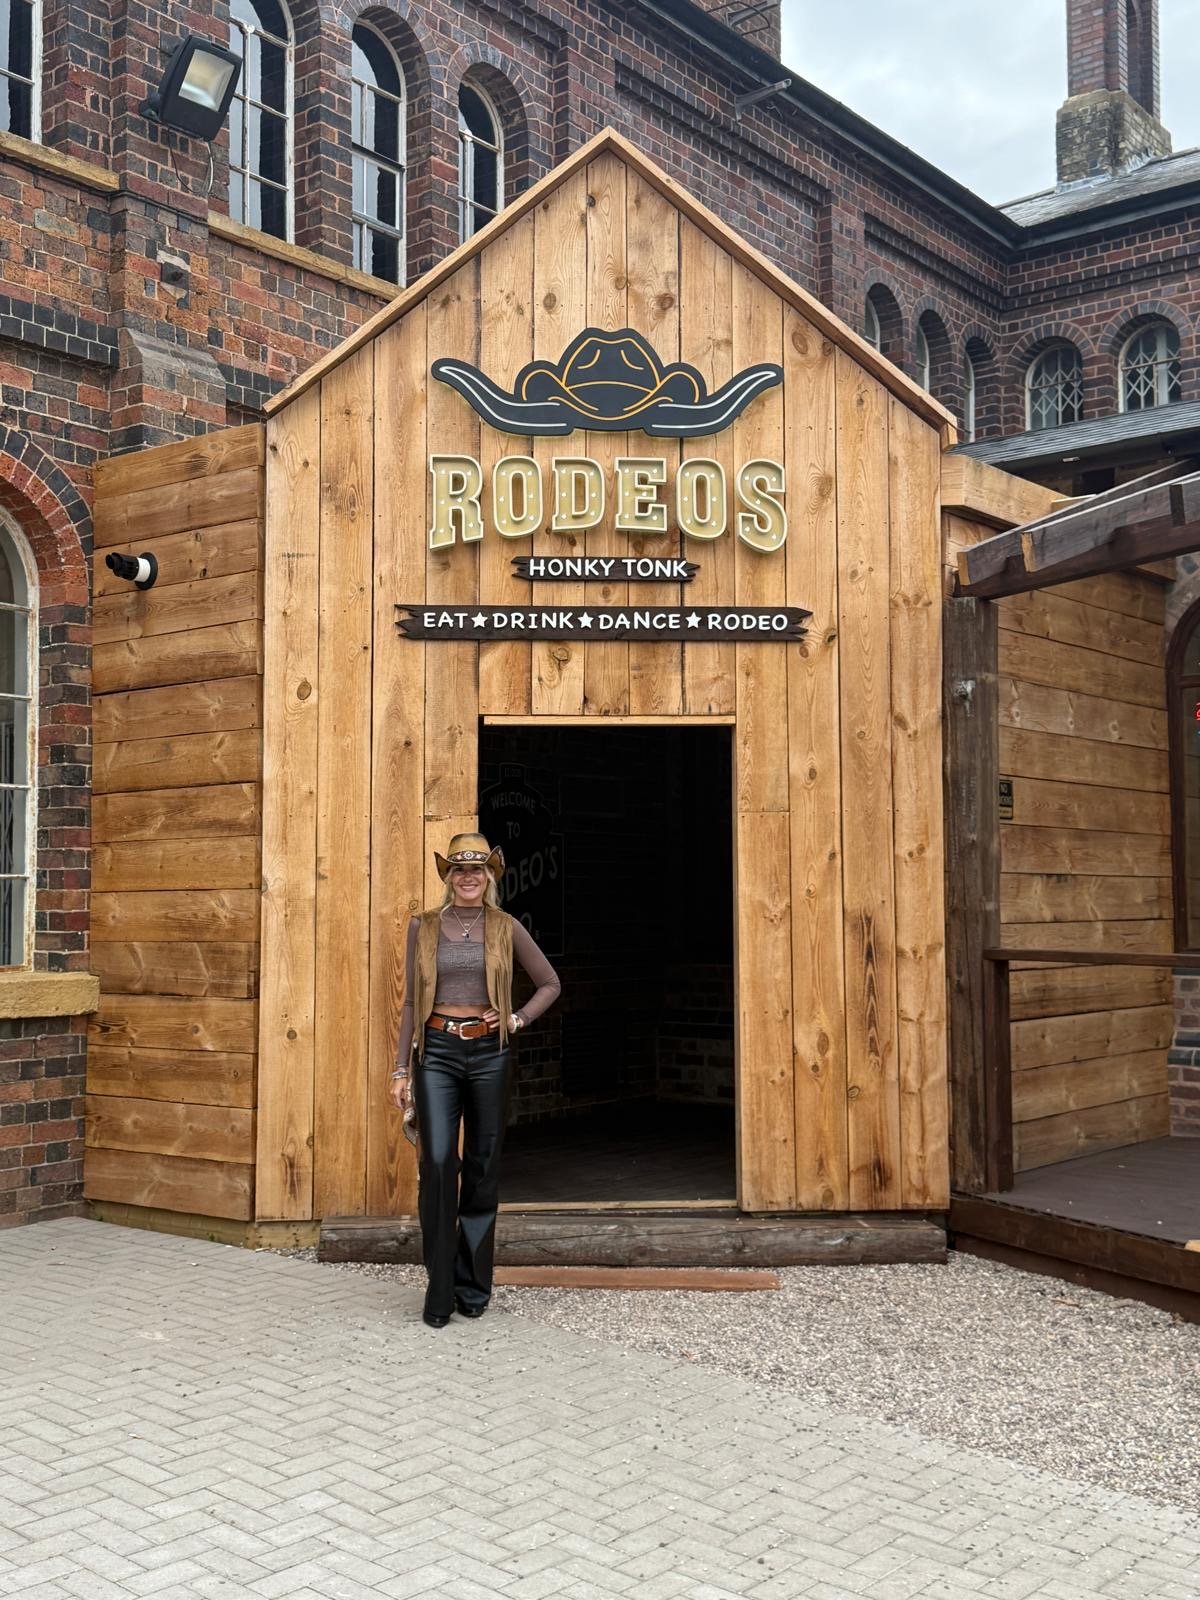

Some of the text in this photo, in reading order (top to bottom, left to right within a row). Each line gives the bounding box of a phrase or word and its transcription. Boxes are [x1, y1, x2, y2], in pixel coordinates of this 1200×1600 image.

[429, 455, 788, 551] RODEOS
[529, 559, 688, 577] HONKY TONK
[423, 611, 788, 631] EAT DRINK DANCE RODEO
[490, 791, 537, 812] WELCOME
[506, 821, 521, 840] TO
[496, 845, 559, 905] DEO'S
